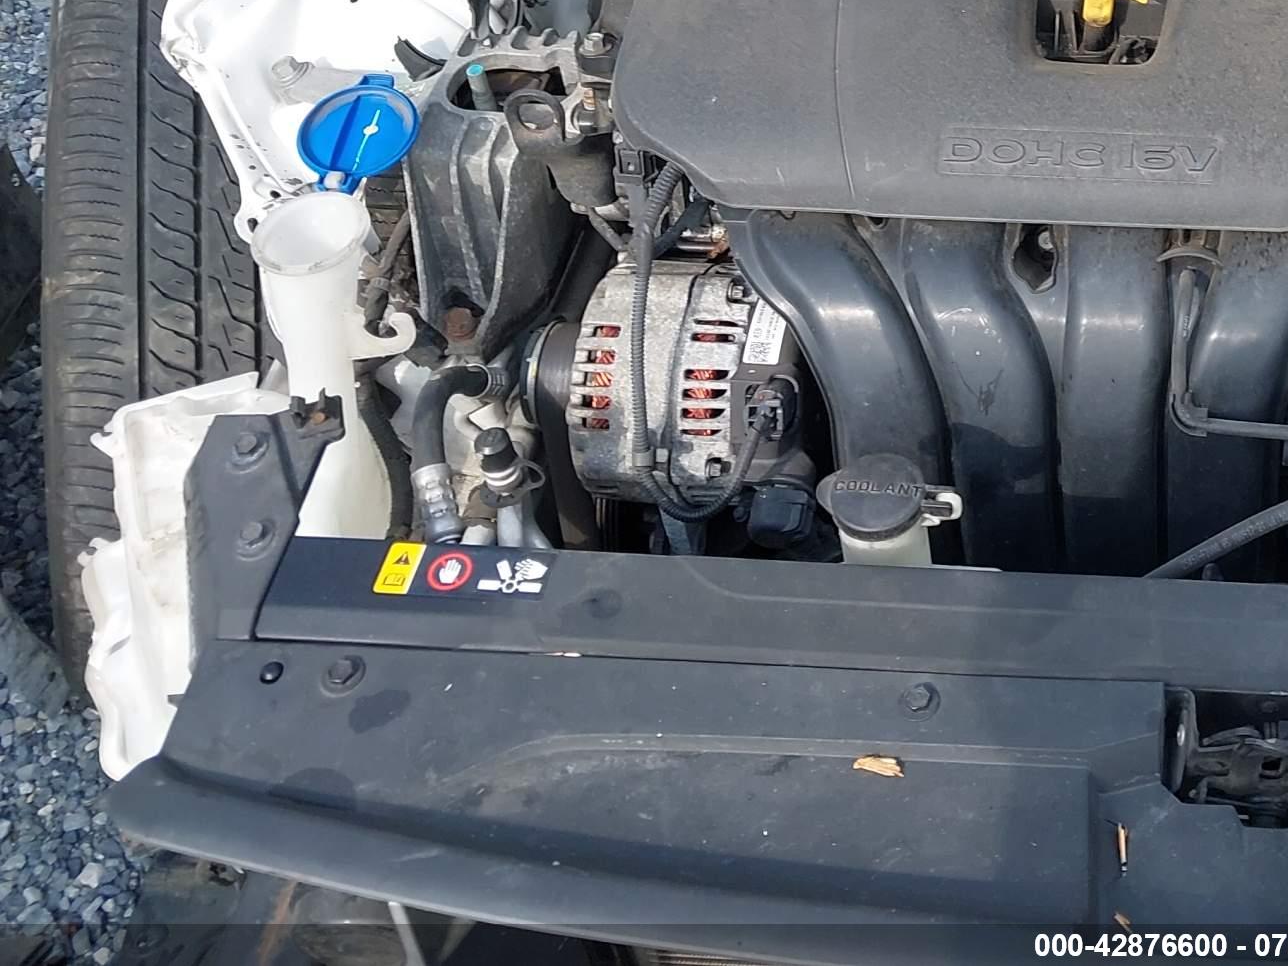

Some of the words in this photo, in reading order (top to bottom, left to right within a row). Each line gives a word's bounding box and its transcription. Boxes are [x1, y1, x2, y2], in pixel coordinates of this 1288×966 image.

[943, 136, 1107, 168] DOHC
[1121, 142, 1218, 173] 16V
[834, 480, 924, 499] COOLANT
